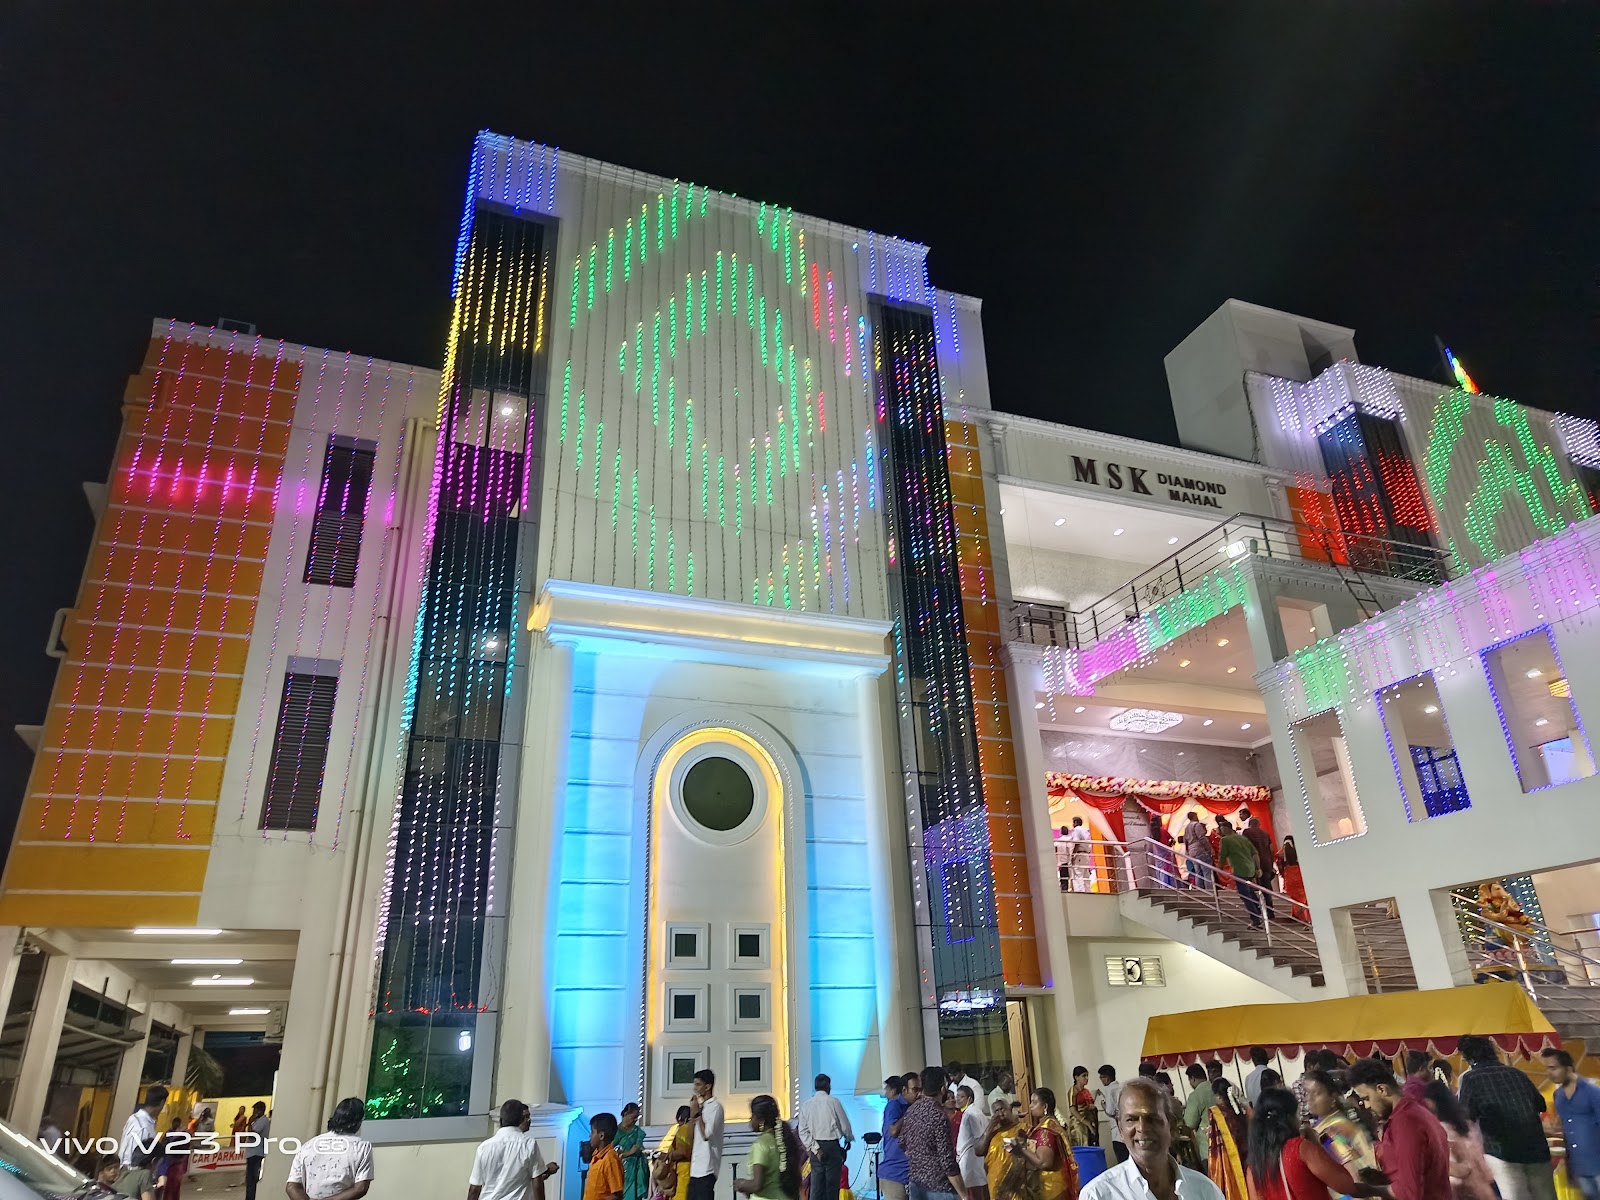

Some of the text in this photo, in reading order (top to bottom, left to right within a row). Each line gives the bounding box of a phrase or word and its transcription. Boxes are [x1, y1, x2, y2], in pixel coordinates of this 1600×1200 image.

[1157, 473, 1227, 495] DIAMOND
[1169, 489, 1223, 509] MAHAL
[192, 1150, 246, 1164] CAR PARKIN
